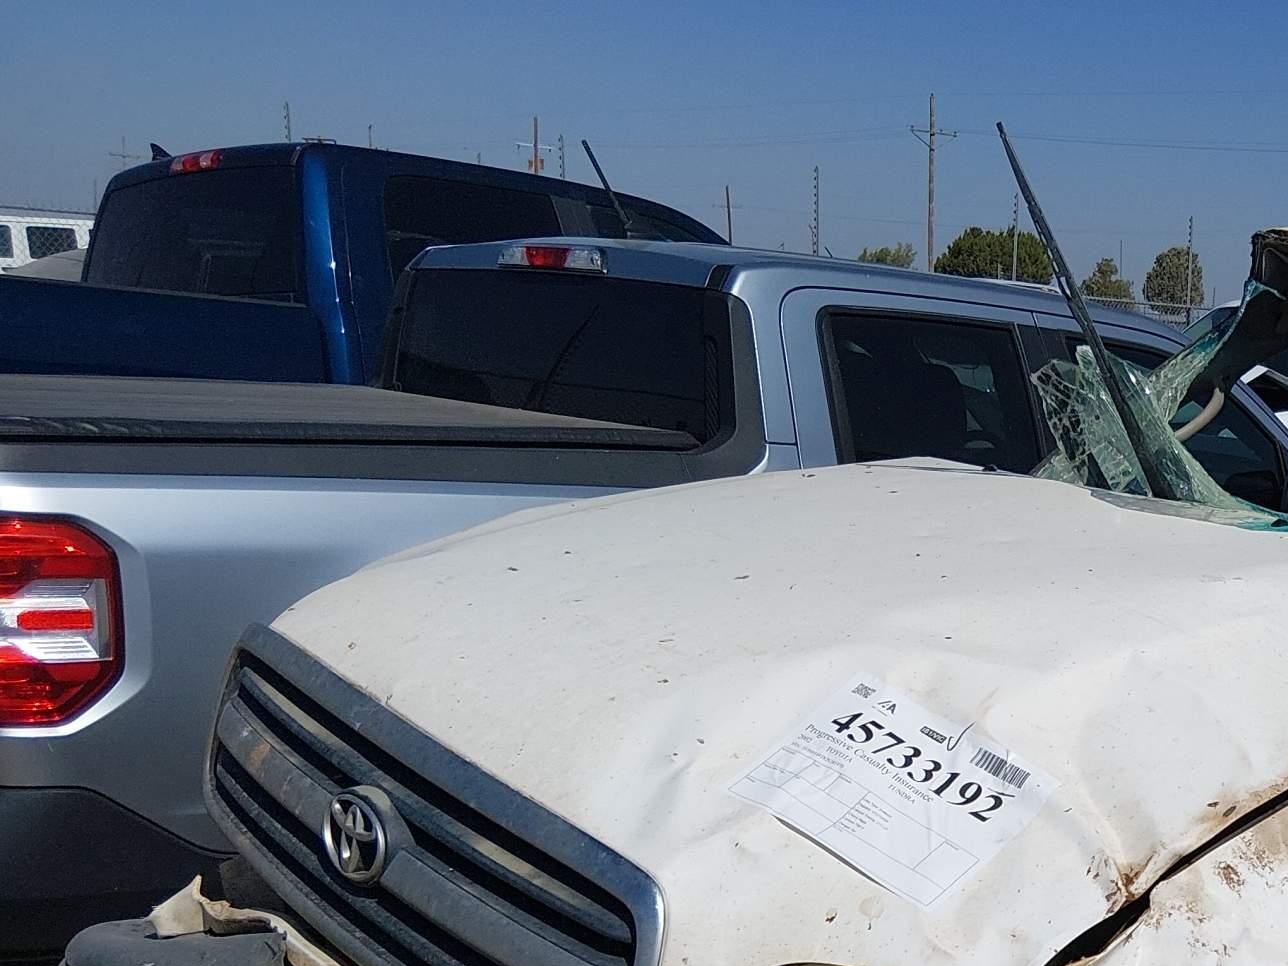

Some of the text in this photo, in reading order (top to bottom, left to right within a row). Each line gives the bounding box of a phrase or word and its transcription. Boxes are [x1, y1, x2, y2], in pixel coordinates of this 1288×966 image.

[805, 723, 854, 750] Progressive
[854, 749, 890, 776] Casualty
[891, 773, 933, 802] Insurance
[831, 712, 1003, 822] 45733192
